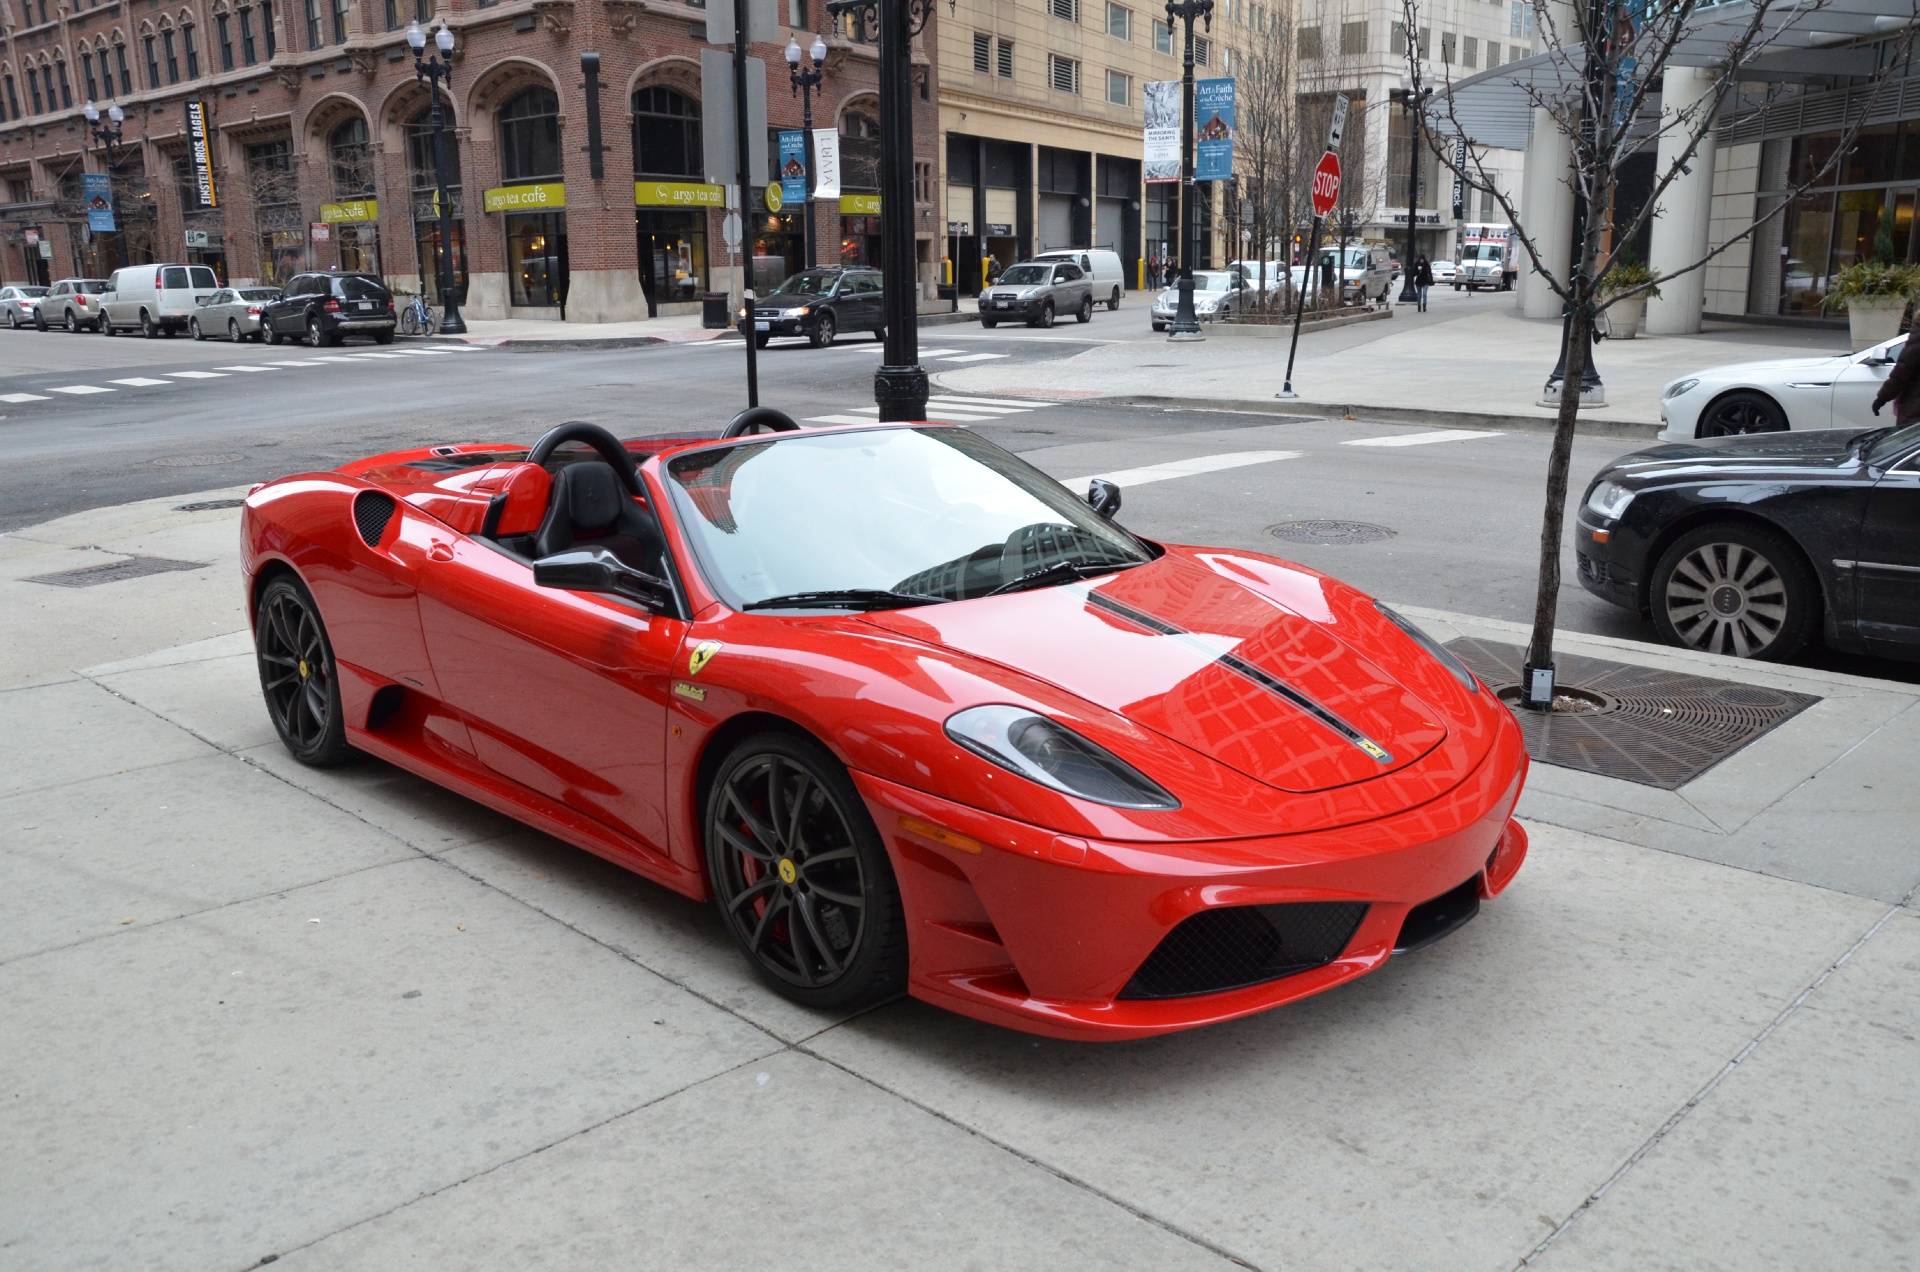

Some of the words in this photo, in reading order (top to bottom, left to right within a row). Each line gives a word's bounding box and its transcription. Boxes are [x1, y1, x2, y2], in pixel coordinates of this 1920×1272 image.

[1199, 86, 1211, 95] Art
[1215, 83, 1233, 93] Faith
[189, 103, 204, 137] BAGELS
[820, 137, 833, 186] LUMA
[197, 165, 212, 205] EINSTEIN
[506, 192, 520, 204] tea
[521, 185, 547, 203] café
[1314, 170, 1339, 199] STOP
[1453, 184, 1463, 207] rack
[673, 190, 695, 204] argo
[696, 189, 708, 201] tea
[867, 200, 881, 213] arg
